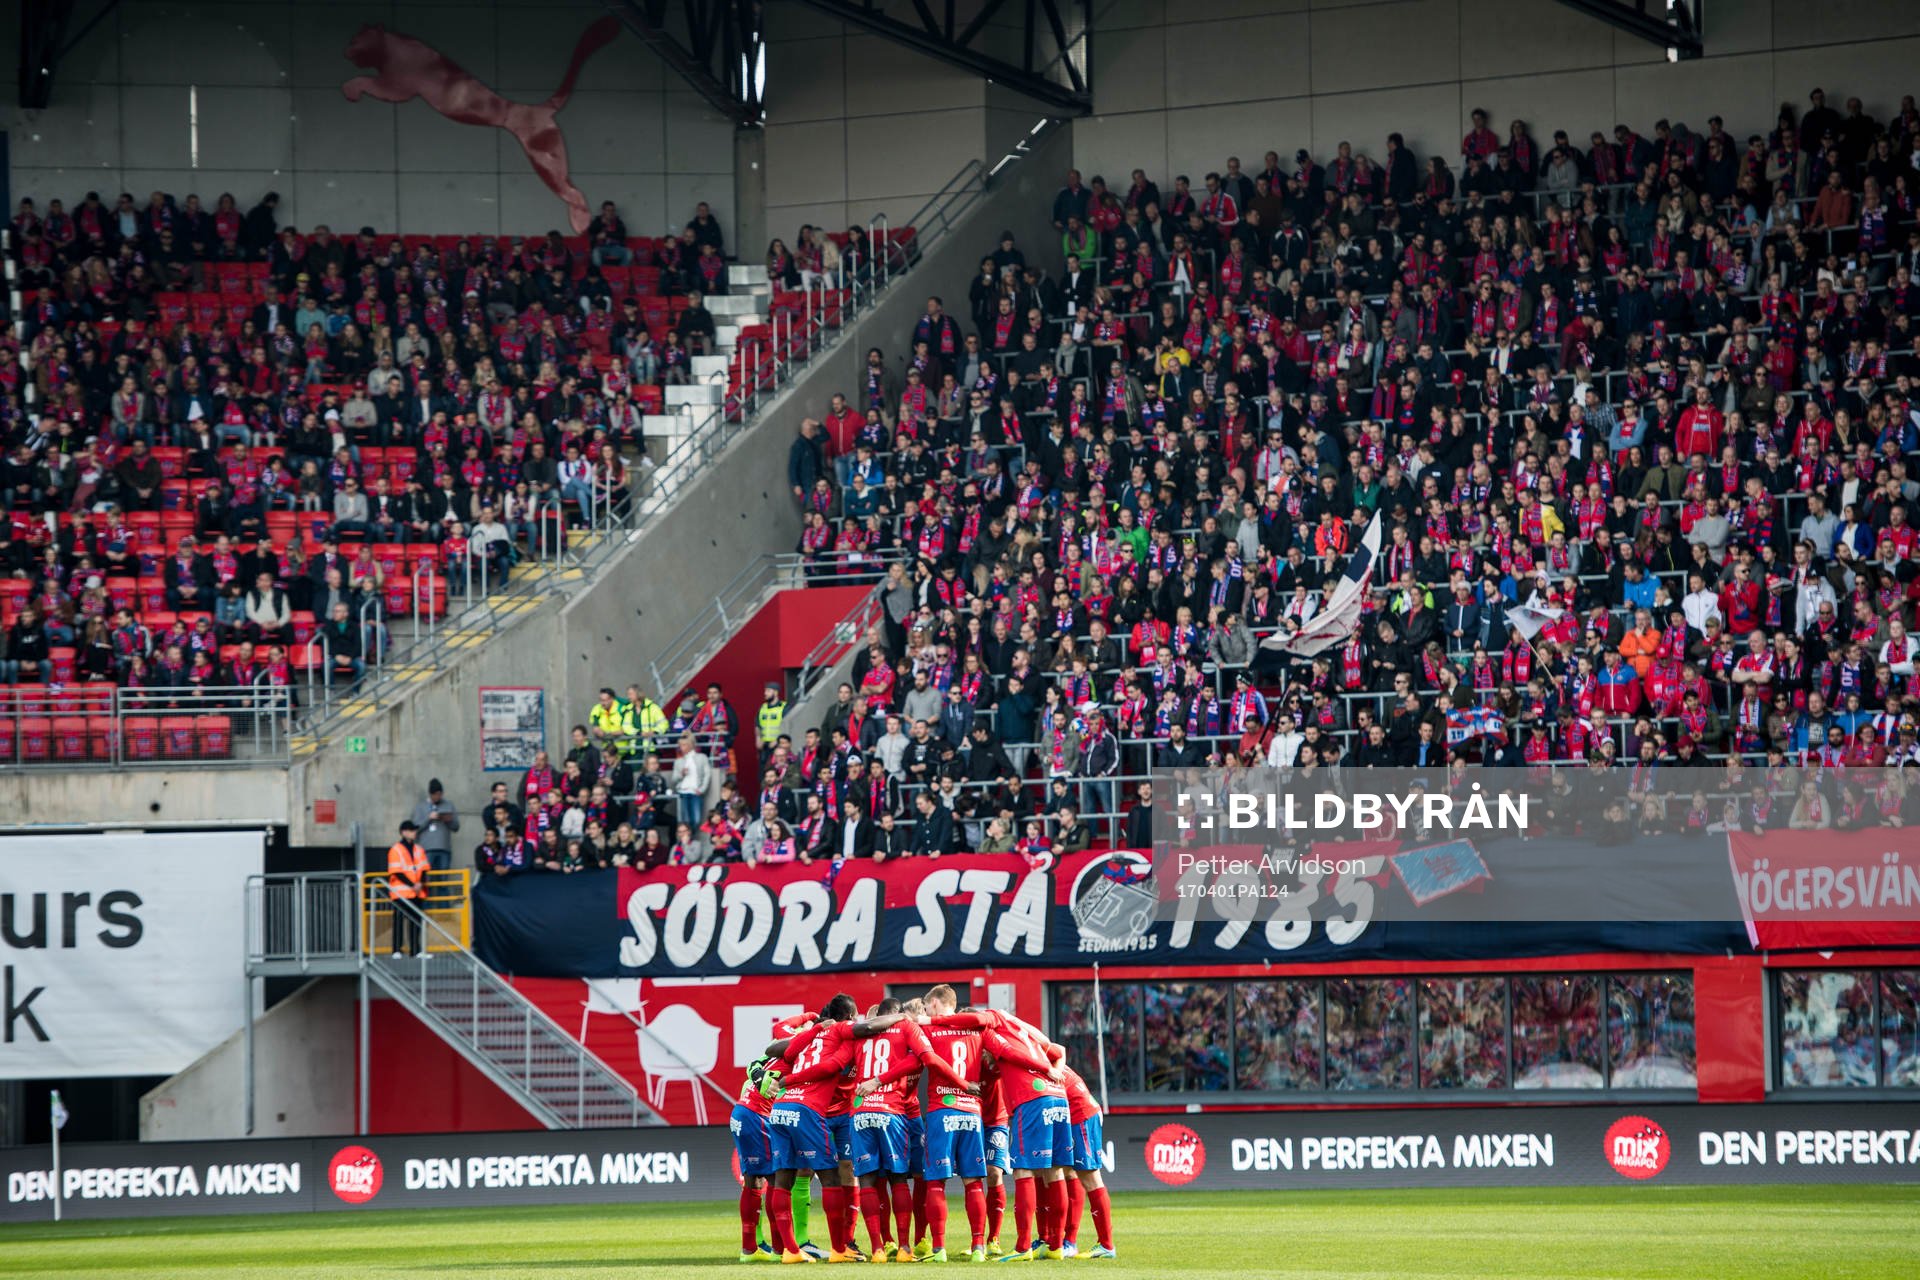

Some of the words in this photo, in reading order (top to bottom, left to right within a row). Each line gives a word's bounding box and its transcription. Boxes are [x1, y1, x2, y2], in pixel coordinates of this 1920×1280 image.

[0, 889, 144, 949] urs
[619, 865, 878, 970] SÖDRA
[903, 851, 1052, 957] STÅ
[1169, 854, 1386, 951] 1985
[4, 964, 50, 1043] k
[862, 1038, 890, 1078] 18
[951, 1040, 968, 1081] 8
[1231, 1138, 1294, 1171] DEN
[1301, 1135, 1446, 1170] PERFEKTA
[1453, 1133, 1554, 1168] MIXEN
[1699, 1131, 1767, 1165] DEN
[8, 1170, 56, 1202] DEN
[63, 1165, 200, 1199] PERFEKTA
[205, 1162, 300, 1195] MIXEN
[405, 1158, 461, 1190] DEN
[467, 1154, 595, 1188] PERFEKTA
[600, 1151, 689, 1184] MIXEN
